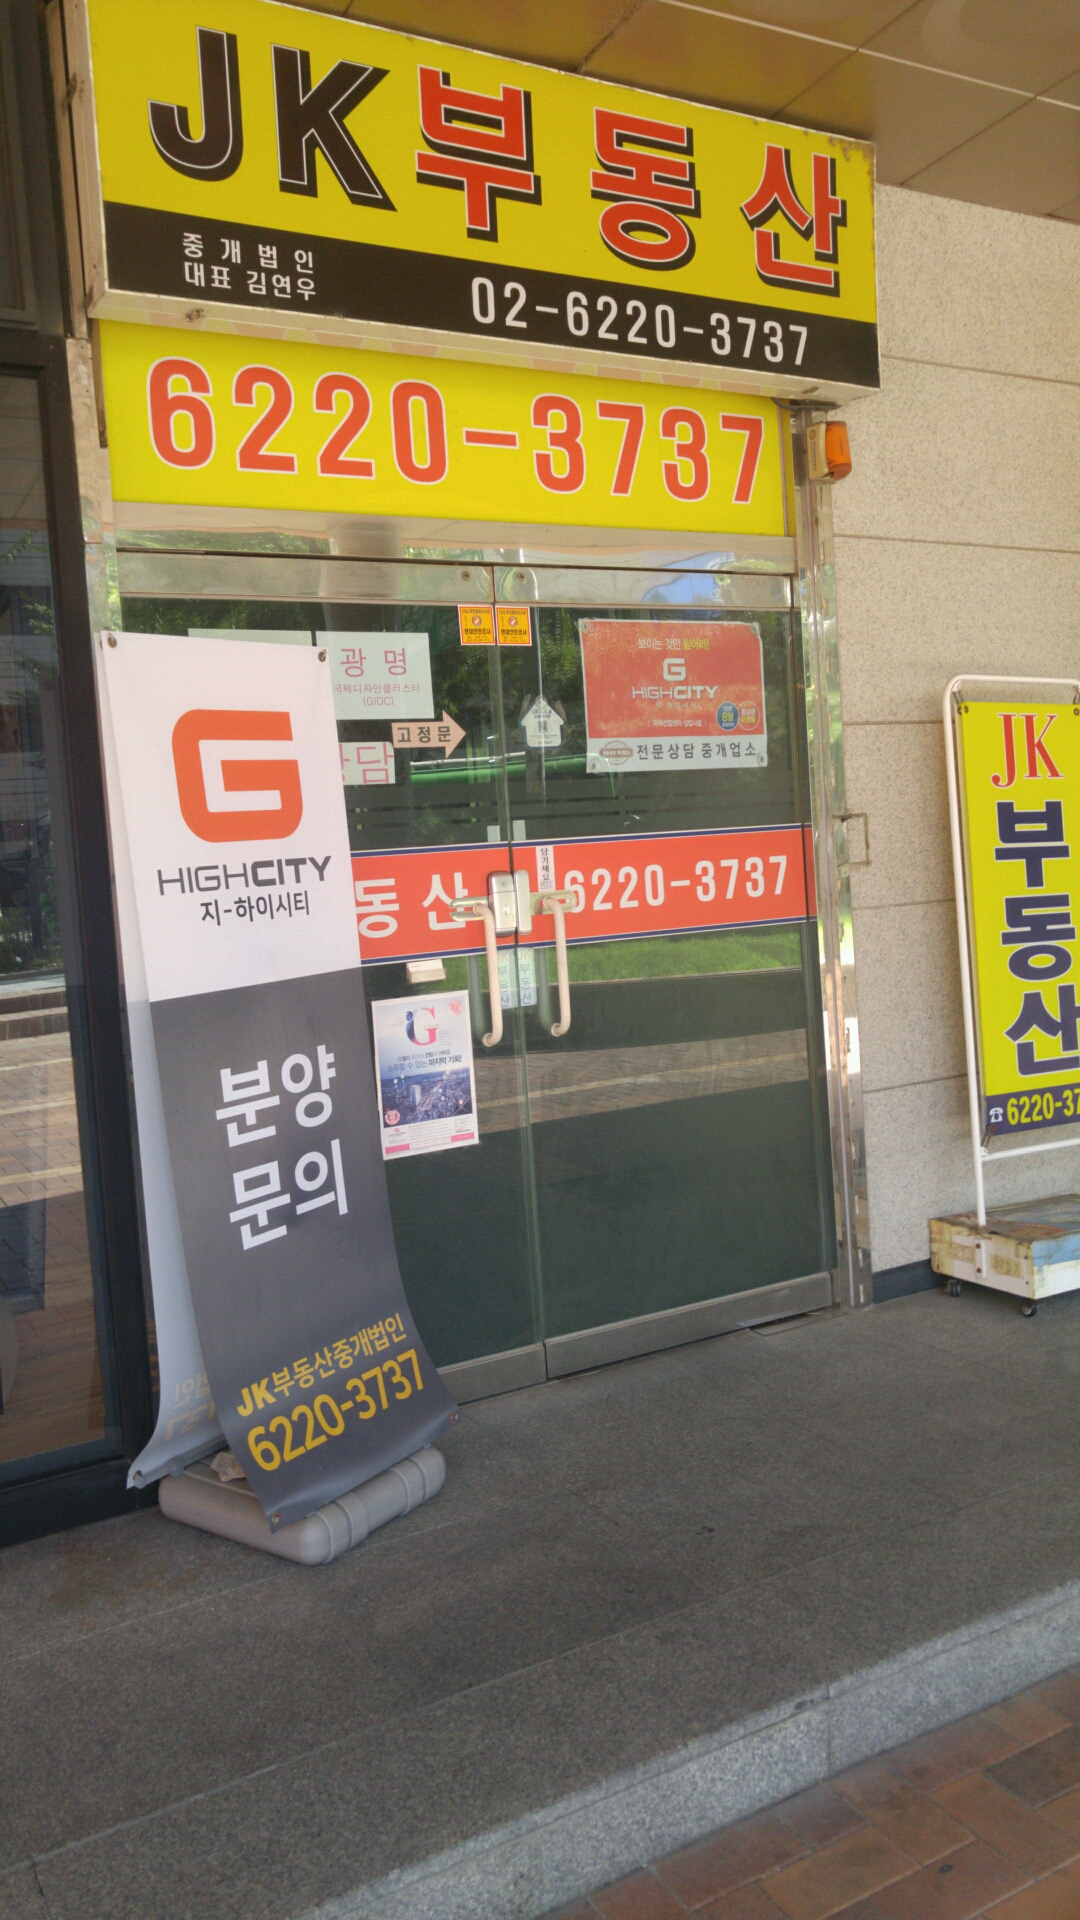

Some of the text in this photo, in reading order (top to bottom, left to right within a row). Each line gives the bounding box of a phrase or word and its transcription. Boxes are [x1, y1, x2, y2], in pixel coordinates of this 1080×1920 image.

[184, 261, 316, 301] 대표 김연우
[470, 275, 810, 365] 02-6220-3737
[146, 355, 767, 506] 6220-3737
[332, 682, 421, 696] 국제디자인클러스터
[362, 695, 394, 707] (GIDC)
[631, 685, 719, 700] HIGHCITY
[397, 725, 451, 744] 고정문
[637, 743, 695, 760] 전문상담
[700, 741, 757, 759] 중개업소
[990, 712, 1065, 788] JK
[171, 708, 303, 843] G
[157, 855, 332, 896] HIGHCITY
[563, 855, 788, 914] 6220-3737
[200, 890, 310, 926] 지-하이시티
[387, 1063, 406, 1072] 소유할
[415, 1060, 428, 1069] 있는
[428, 1056, 447, 1066] 마지막
[215, 1043, 337, 1148] 분양
[228, 1137, 349, 1251] 문의
[236, 1312, 408, 1418] JK부동산중개법인
[247, 1348, 425, 1472] 6220-3737
